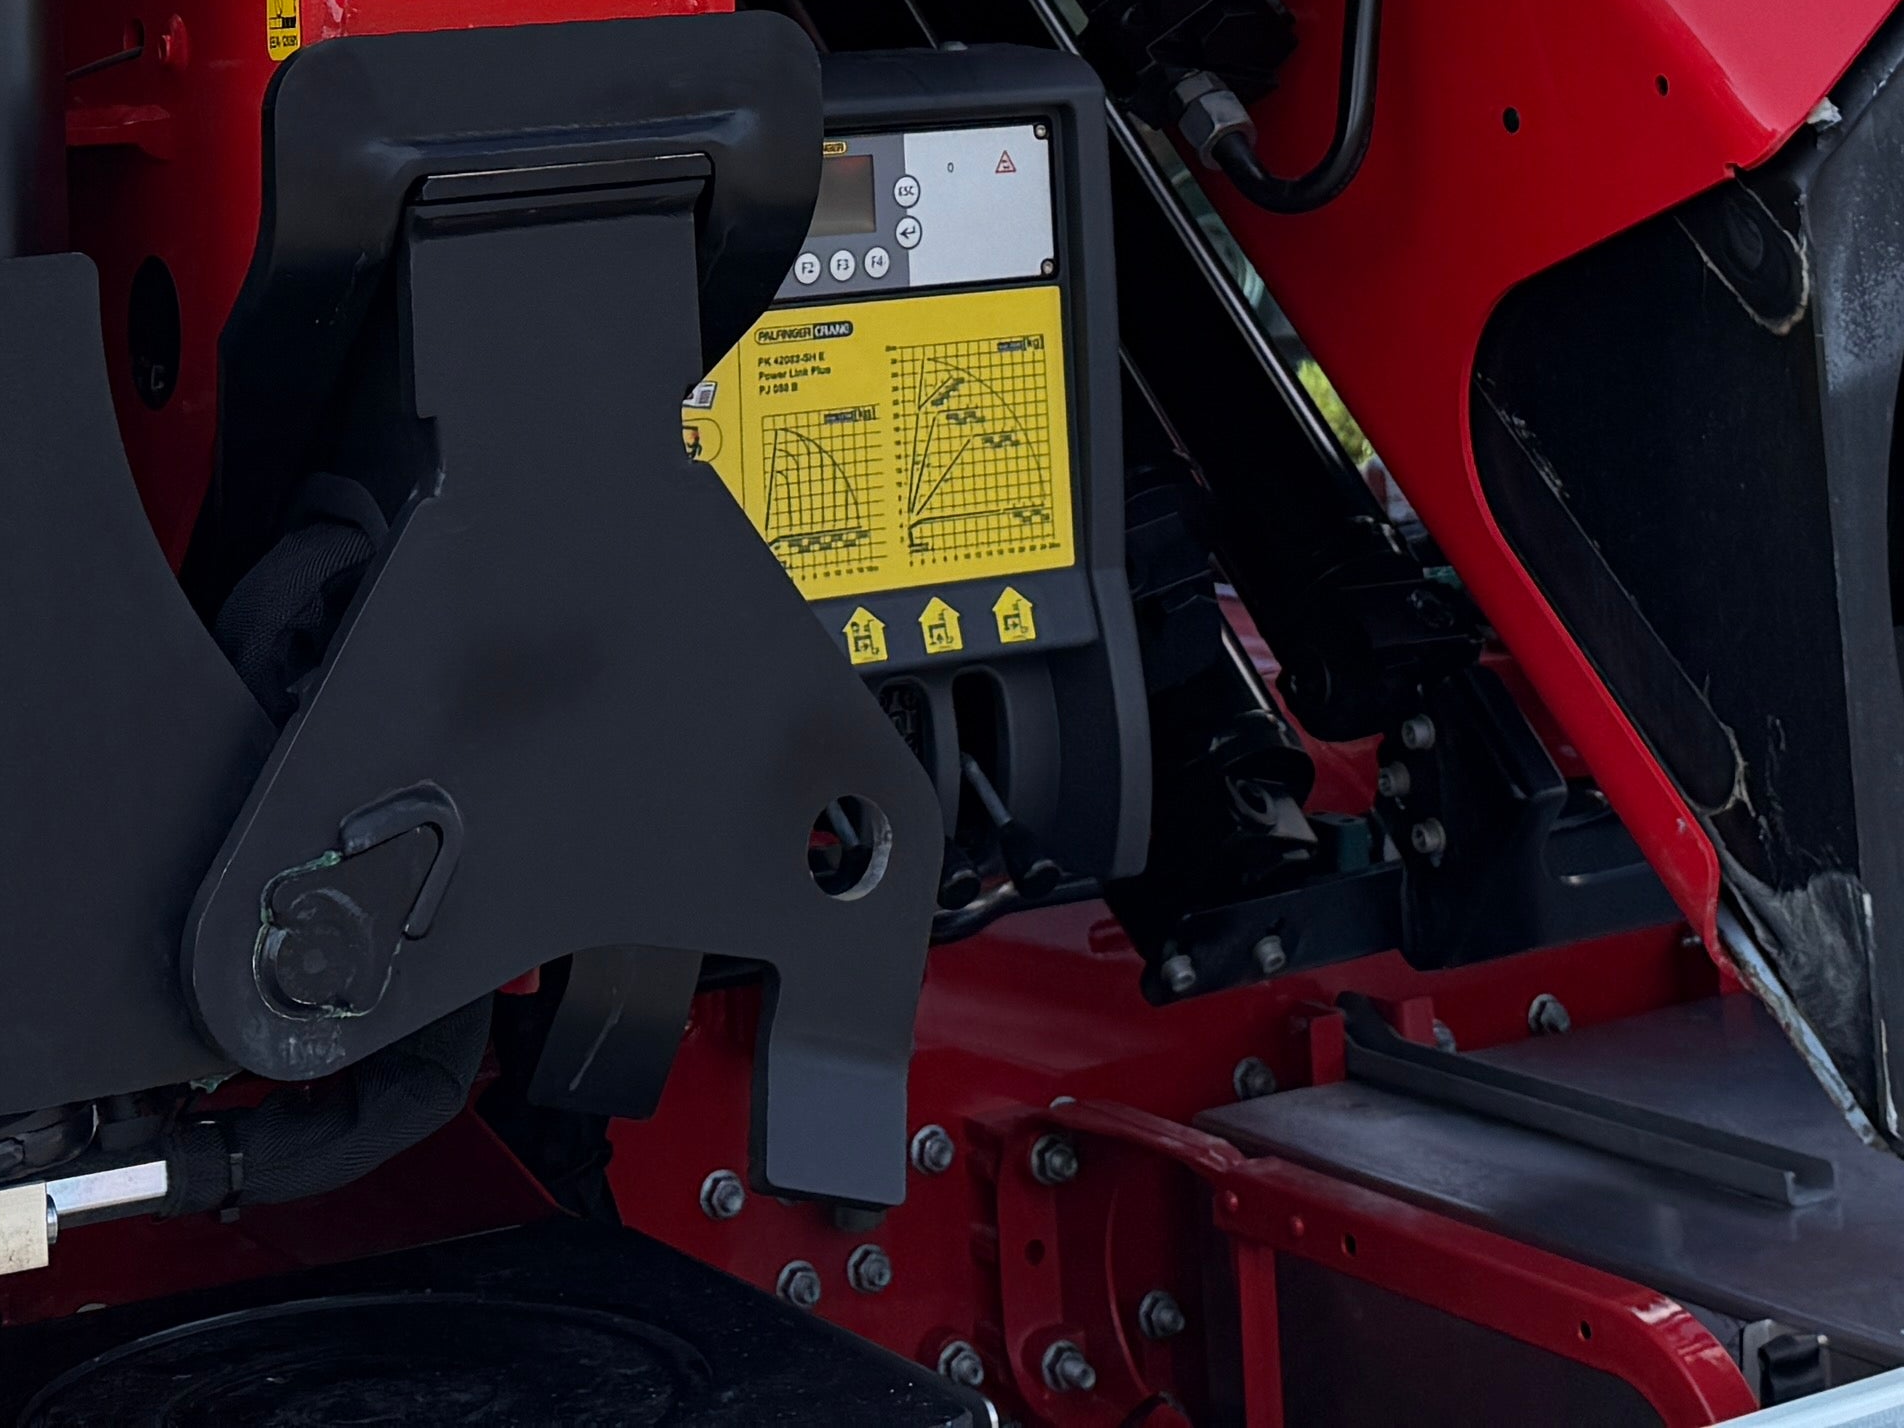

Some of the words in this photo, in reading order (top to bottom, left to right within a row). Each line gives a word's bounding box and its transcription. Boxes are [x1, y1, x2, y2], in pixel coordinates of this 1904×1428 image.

[898, 185, 915, 197] ESC
[802, 261, 815, 274] F2
[837, 258, 849, 271] F3
[871, 255, 883, 268] F4
[758, 327, 811, 342] PALFINGER
[759, 370, 787, 381] Power
